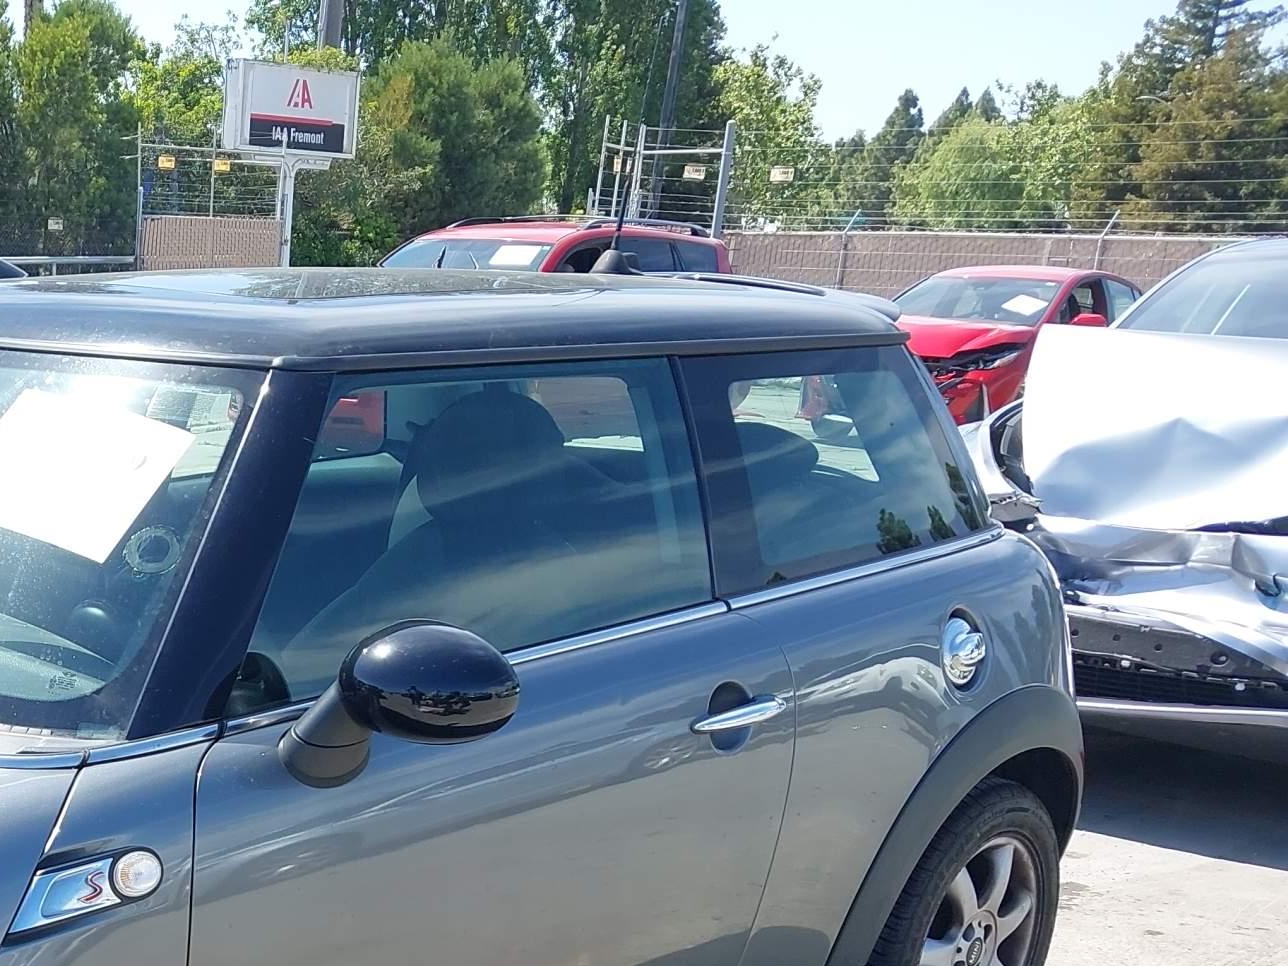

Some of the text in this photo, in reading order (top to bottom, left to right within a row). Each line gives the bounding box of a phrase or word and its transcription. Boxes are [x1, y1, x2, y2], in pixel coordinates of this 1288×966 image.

[272, 125, 324, 145] IAA Fremont
[78, 870, 105, 904] S
